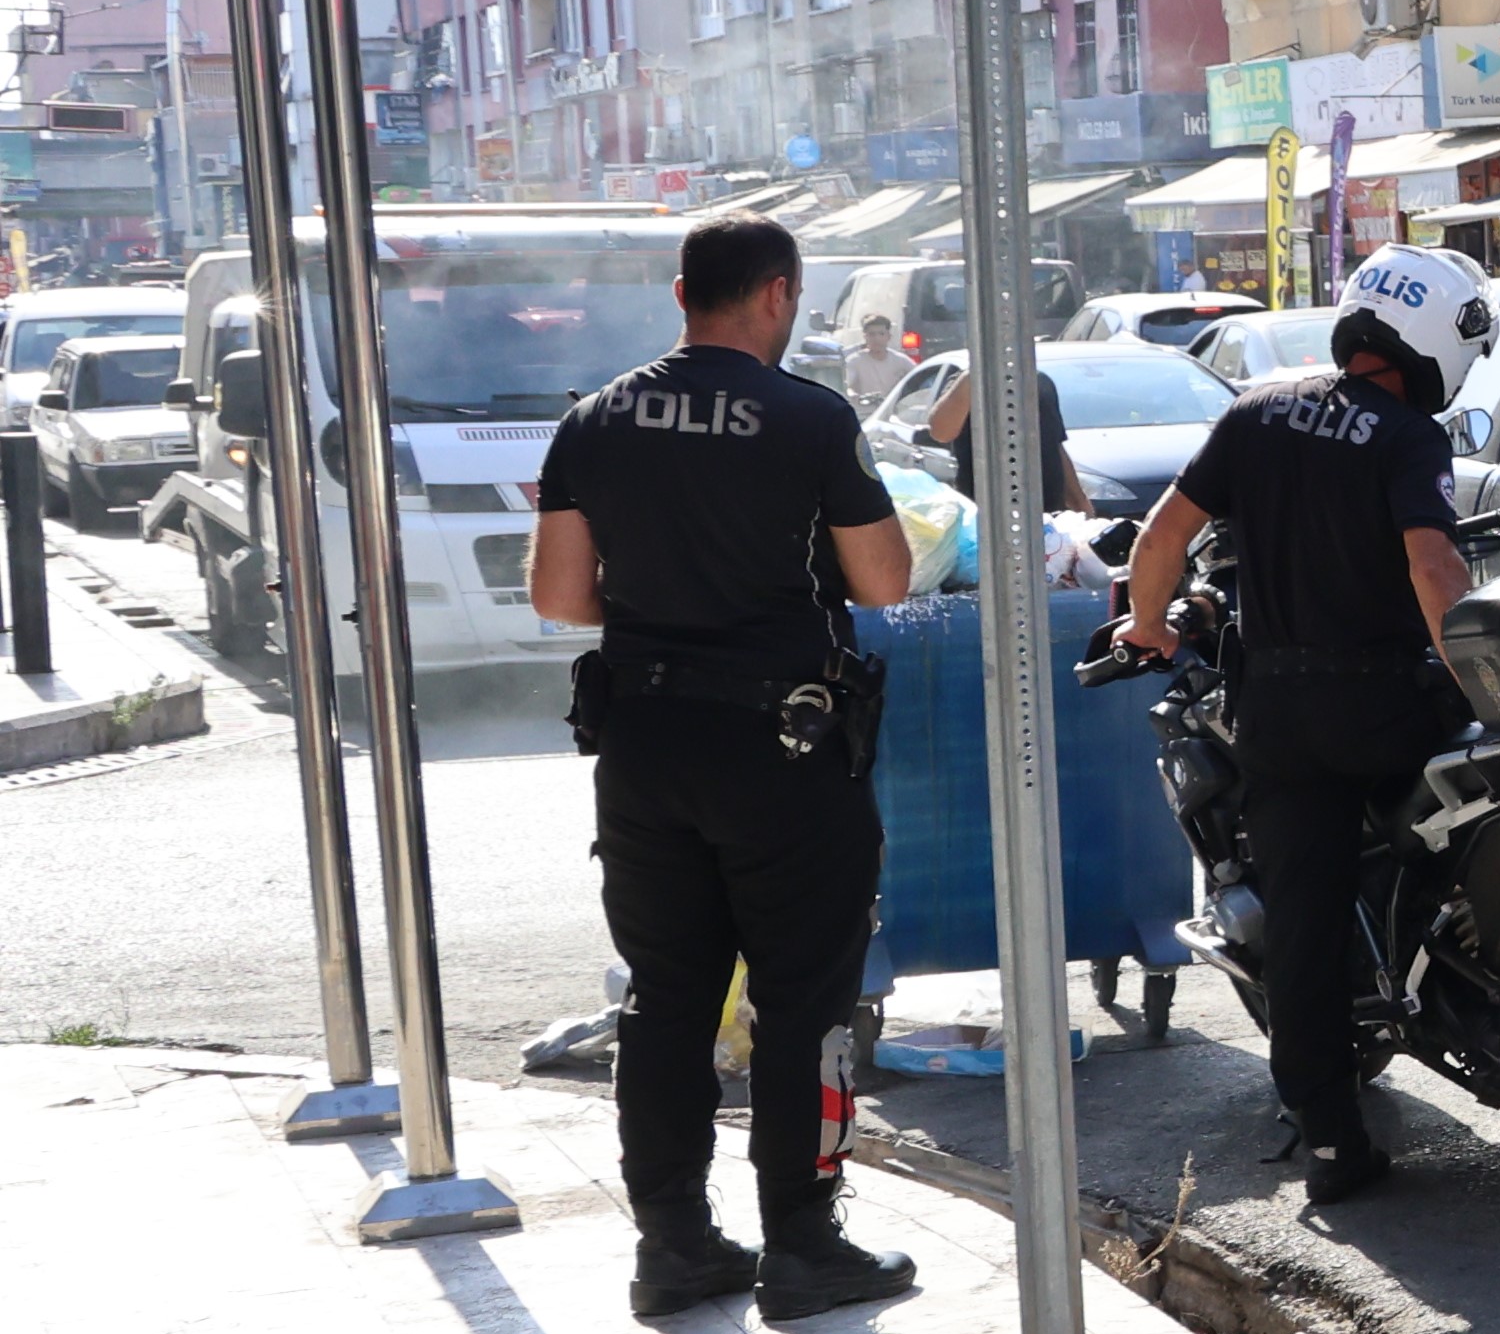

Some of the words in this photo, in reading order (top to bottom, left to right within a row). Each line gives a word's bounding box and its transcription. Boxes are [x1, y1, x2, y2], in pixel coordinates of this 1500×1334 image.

[1451, 95, 1475, 106] Türk
[1184, 112, 1210, 136] İKİ
[600, 386, 763, 437] POLİS
